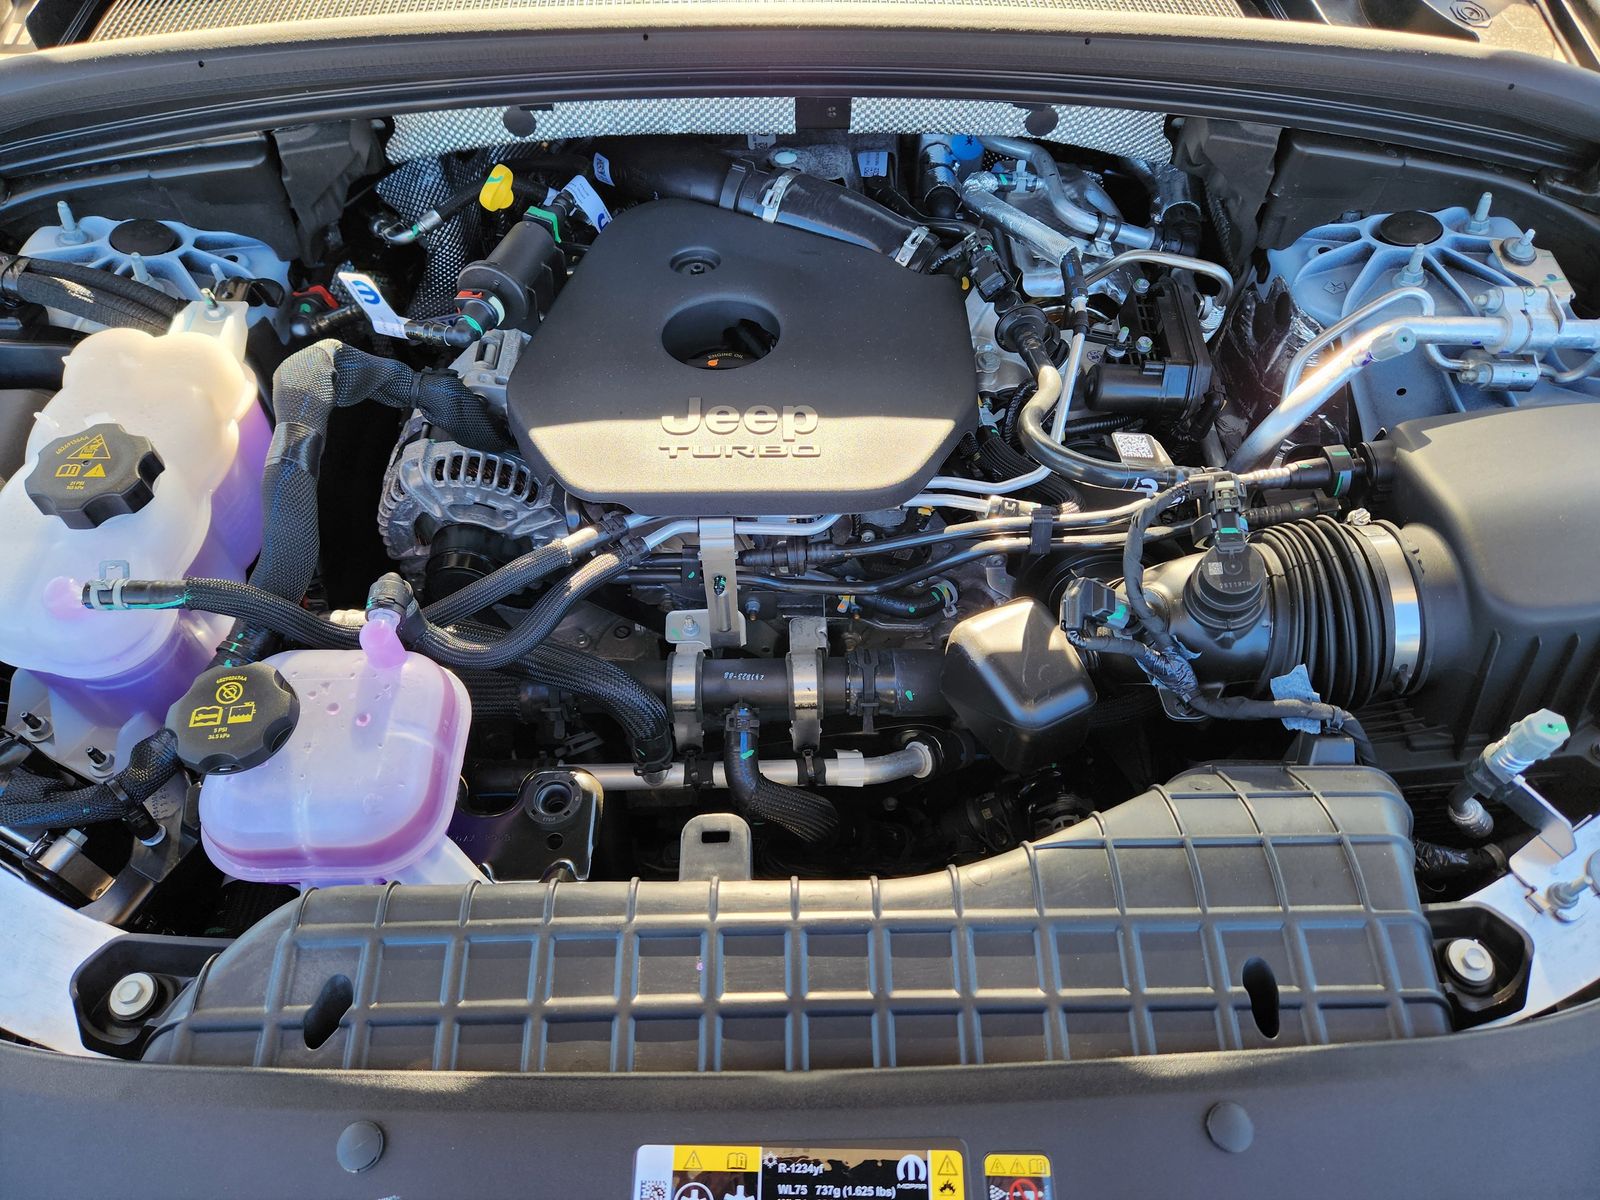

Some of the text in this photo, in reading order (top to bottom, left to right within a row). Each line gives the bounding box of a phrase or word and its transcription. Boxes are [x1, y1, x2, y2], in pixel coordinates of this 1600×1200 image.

[660, 396, 819, 442] Jeep
[658, 444, 822, 459] TURBO
[777, 1162, 825, 1177] R-1234yf
[777, 1184, 897, 1198] WL75 737g (1.625 lbs)
